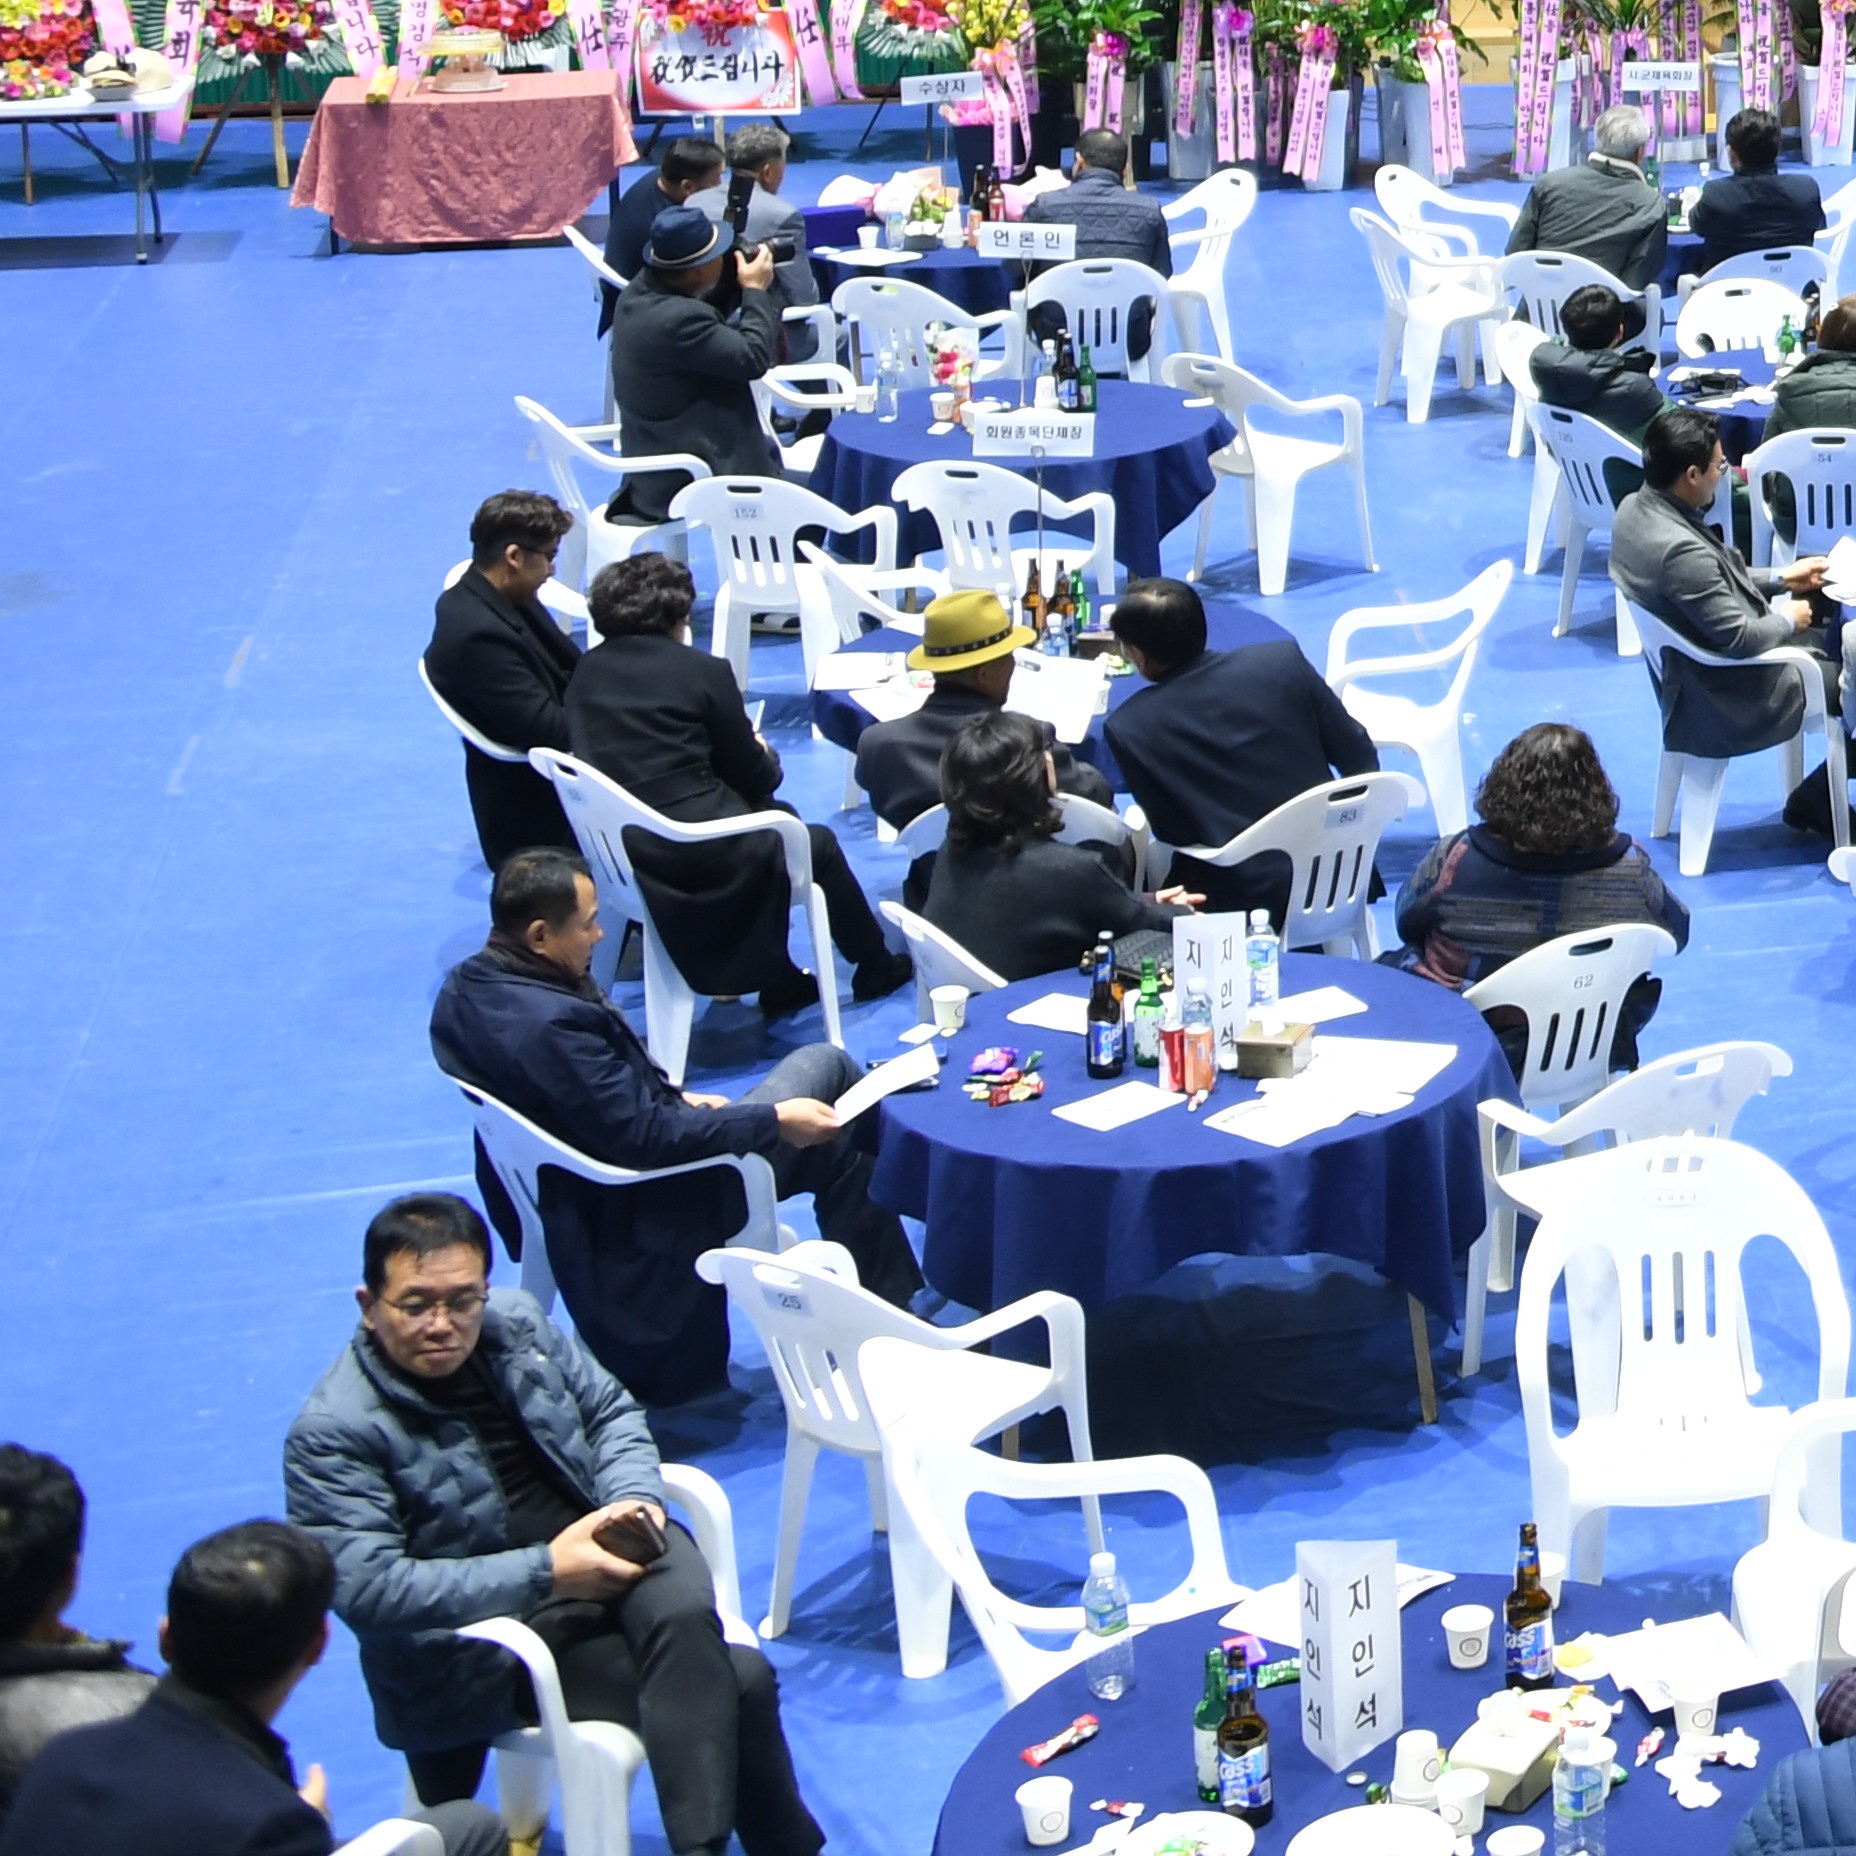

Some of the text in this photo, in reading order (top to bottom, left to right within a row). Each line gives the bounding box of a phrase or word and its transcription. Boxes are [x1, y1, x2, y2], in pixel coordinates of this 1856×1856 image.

[918, 78, 966, 96] 수상자
[1817, 453, 1832, 463] 54
[1339, 808, 1357, 824] 83
[1573, 973, 1594, 990] 62
[1220, 935, 1237, 1050] 지인석
[779, 1293, 802, 1310] 25
[1304, 1577, 1322, 1741] 지인석
[1347, 1574, 1378, 1730] 지인석
